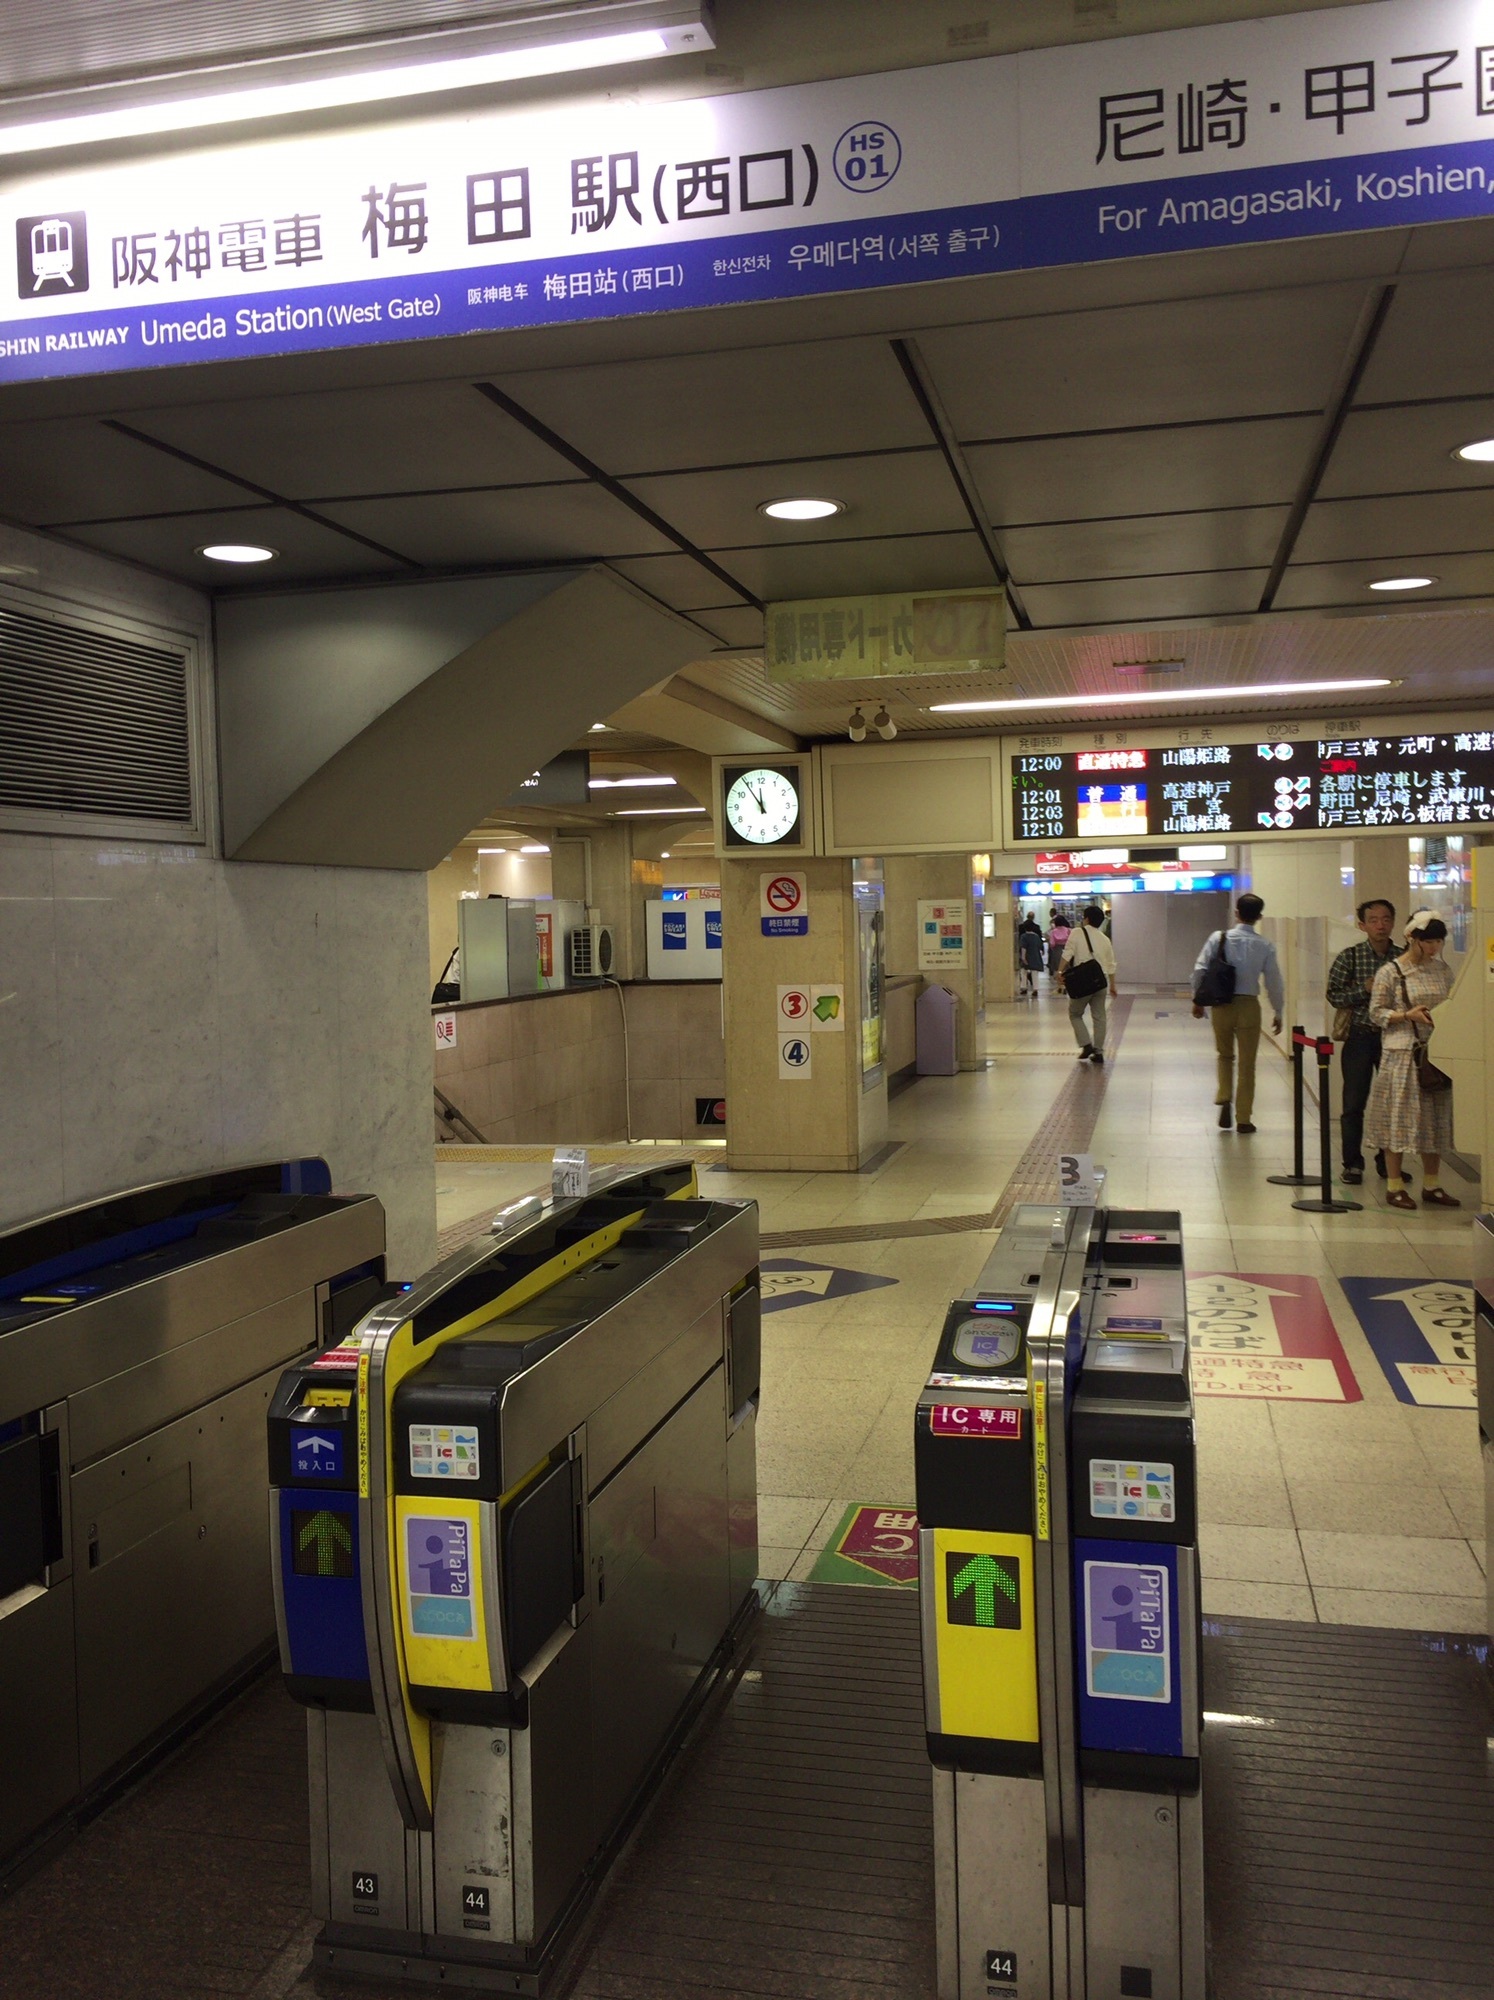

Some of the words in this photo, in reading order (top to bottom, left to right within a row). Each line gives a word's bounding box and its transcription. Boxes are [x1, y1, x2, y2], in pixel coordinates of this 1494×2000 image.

[1095, 45, 1494, 166] 尼崎・甲子
[850, 131, 885, 152] HS
[845, 154, 889, 182] 01
[1098, 205, 1143, 234] For
[1158, 179, 1342, 228] Amagasaki,
[1356, 164, 1494, 203] Koshien,
[111, 213, 324, 289] 阪神電車
[712, 253, 772, 276] 한신전차
[946, 224, 1001, 254] 출구)
[467, 280, 529, 305] 阪神电车
[542, 264, 685, 302] 梅田站(西口)
[45, 326, 129, 352] RAILWAY
[140, 312, 227, 346] Umeda
[234, 303, 324, 335] Station
[388, 293, 441, 322] Gate)
[1020, 757, 1062, 772] 12:00
[1318, 731, 1494, 759] 戸三宮・元町・高速
[1021, 790, 1062, 804] 12:01
[1162, 780, 1232, 800] 高速神戸
[1319, 768, 1467, 793] 各駅に停車します
[1022, 806, 1063, 821] 12:03
[1022, 822, 1063, 837] 12:10
[1318, 803, 1494, 828] 戸三宮から板宿まで
[977, 1341, 993, 1350] IC
[941, 1406, 969, 1423] IC
[977, 1408, 1017, 1424] 専用
[961, 1426, 989, 1434] カード
[298, 1459, 335, 1472] 投入口
[448, 1520, 467, 1594] PiTaPa
[1140, 1573, 1162, 1650] PiTaPa
[355, 1877, 374, 1894] 43
[465, 1892, 485, 1908] 44
[990, 1958, 1012, 1975] 44
